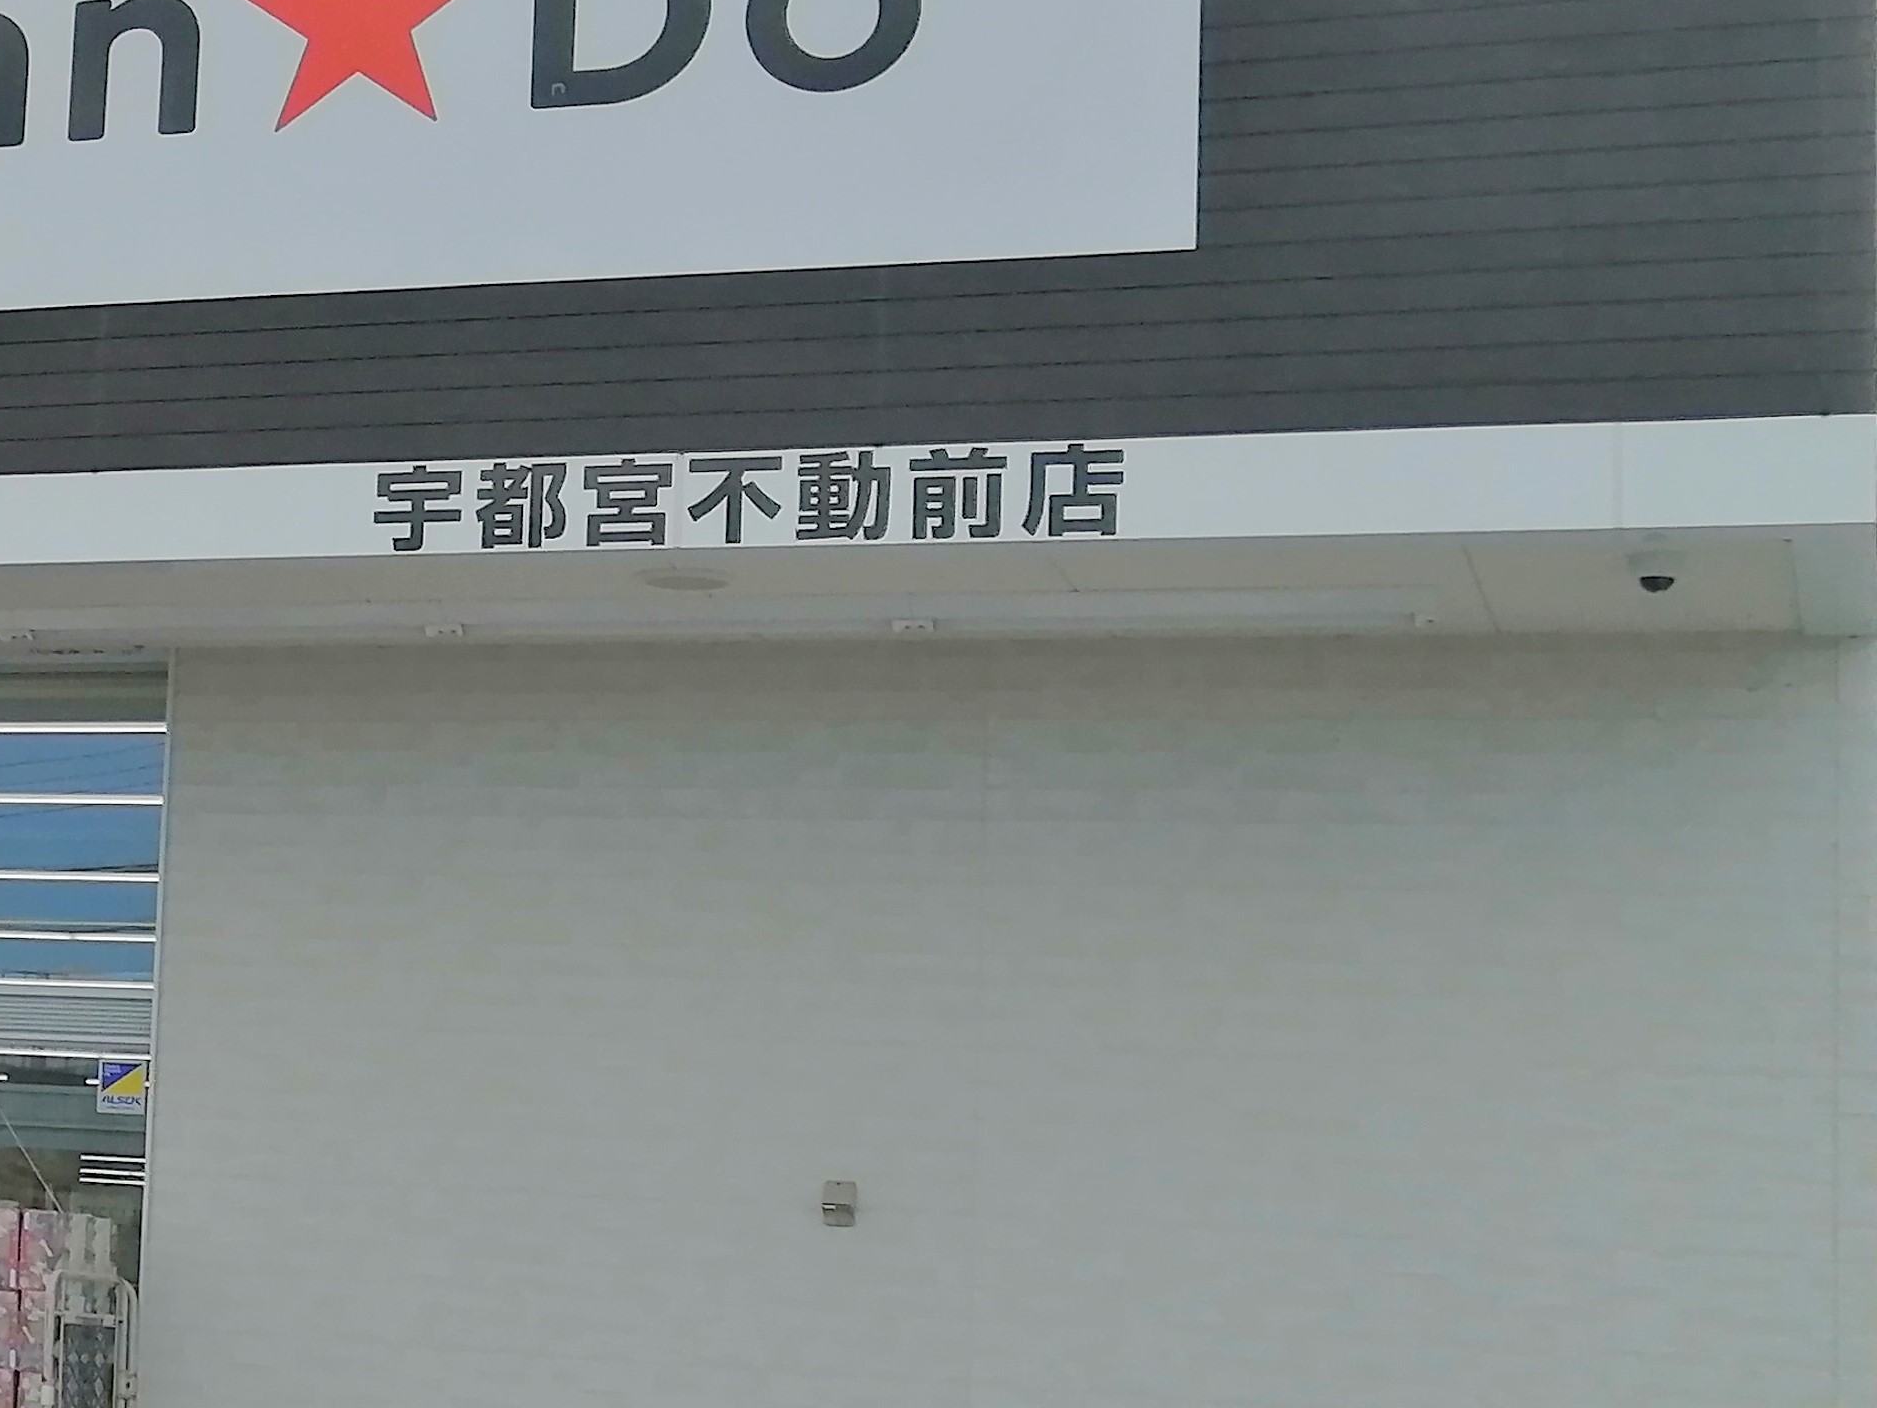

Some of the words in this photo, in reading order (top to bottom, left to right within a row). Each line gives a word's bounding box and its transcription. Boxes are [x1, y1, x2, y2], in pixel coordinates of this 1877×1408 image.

[373, 443, 1125, 551] 宇都宮不動前店
